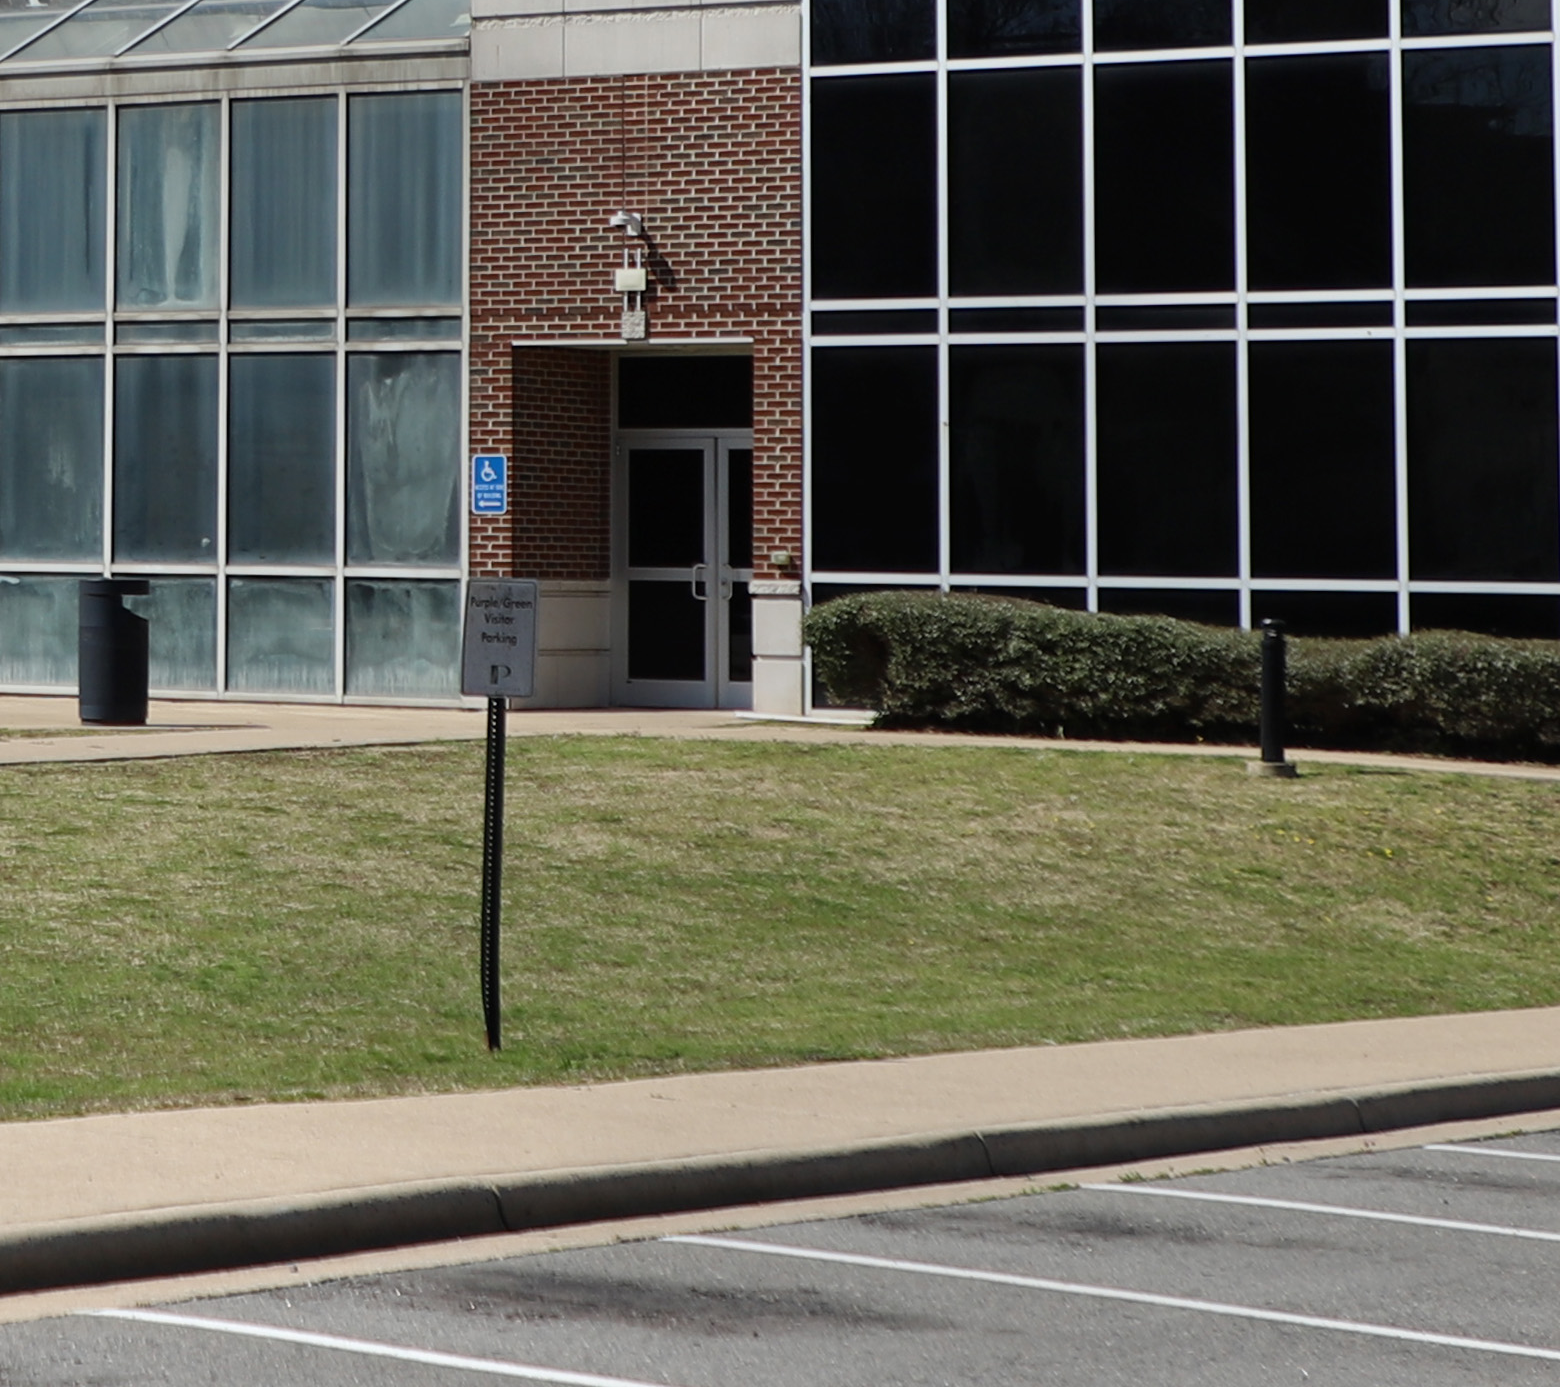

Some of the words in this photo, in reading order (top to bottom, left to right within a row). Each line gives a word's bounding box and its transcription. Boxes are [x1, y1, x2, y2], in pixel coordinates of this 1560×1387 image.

[470, 596, 534, 610] Purple/Green
[484, 613, 515, 625] Visitor
[481, 632, 518, 647] Parking
